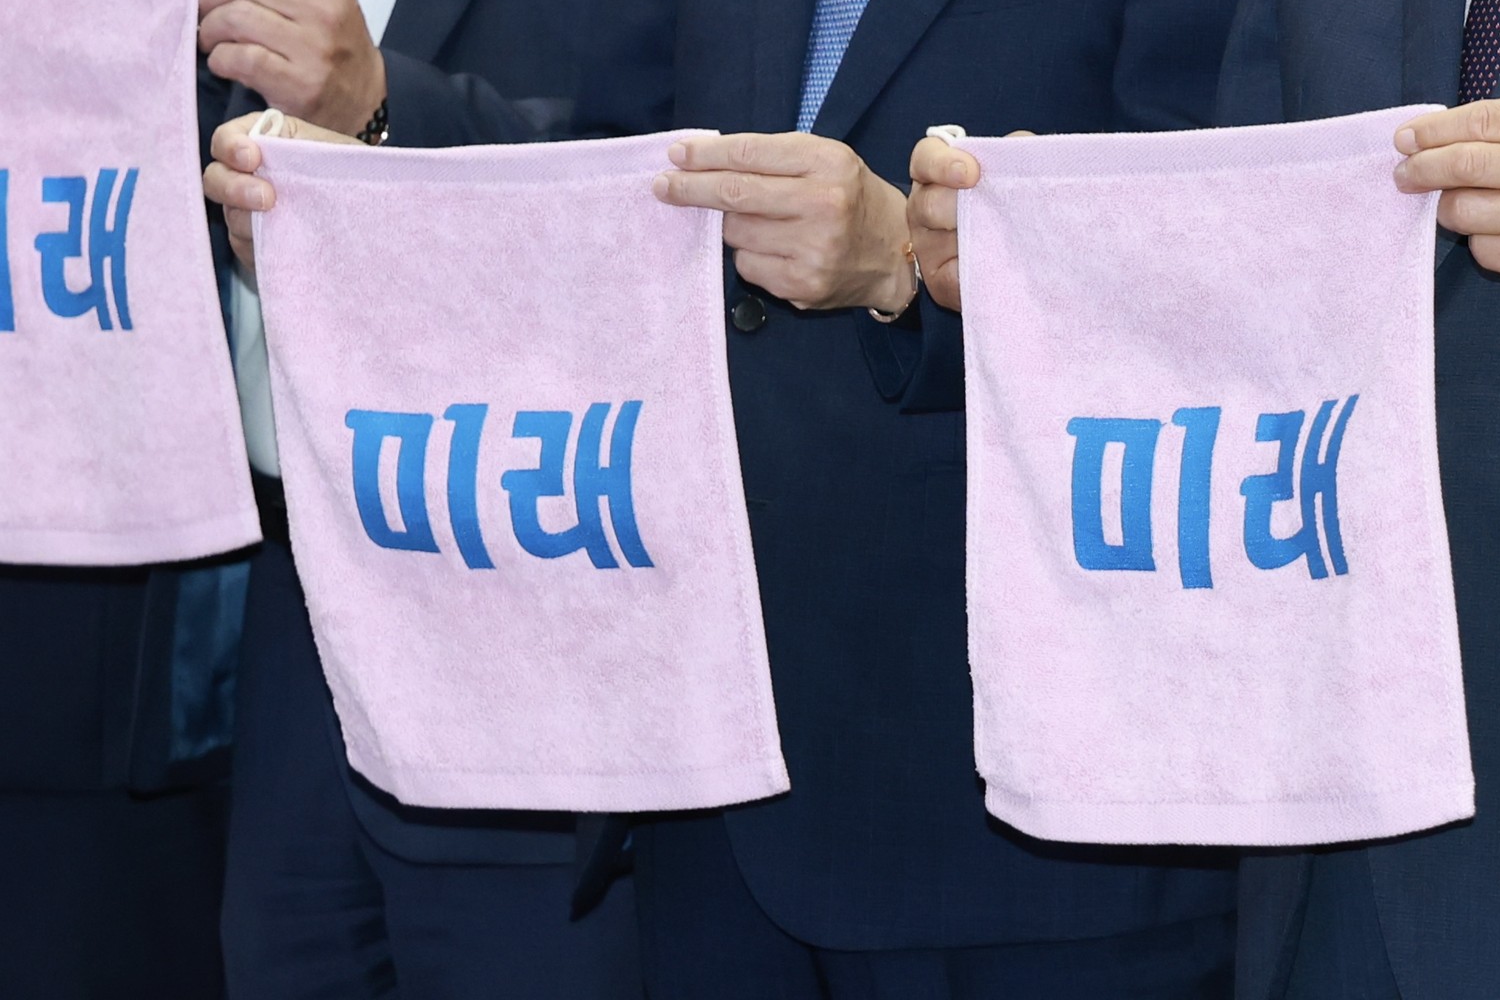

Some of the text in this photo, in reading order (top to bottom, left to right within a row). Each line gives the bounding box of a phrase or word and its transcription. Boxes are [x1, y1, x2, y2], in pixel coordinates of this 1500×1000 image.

[0, 167, 139, 333] 래
[345, 400, 655, 570] 미래
[1066, 394, 1360, 590] 미래
